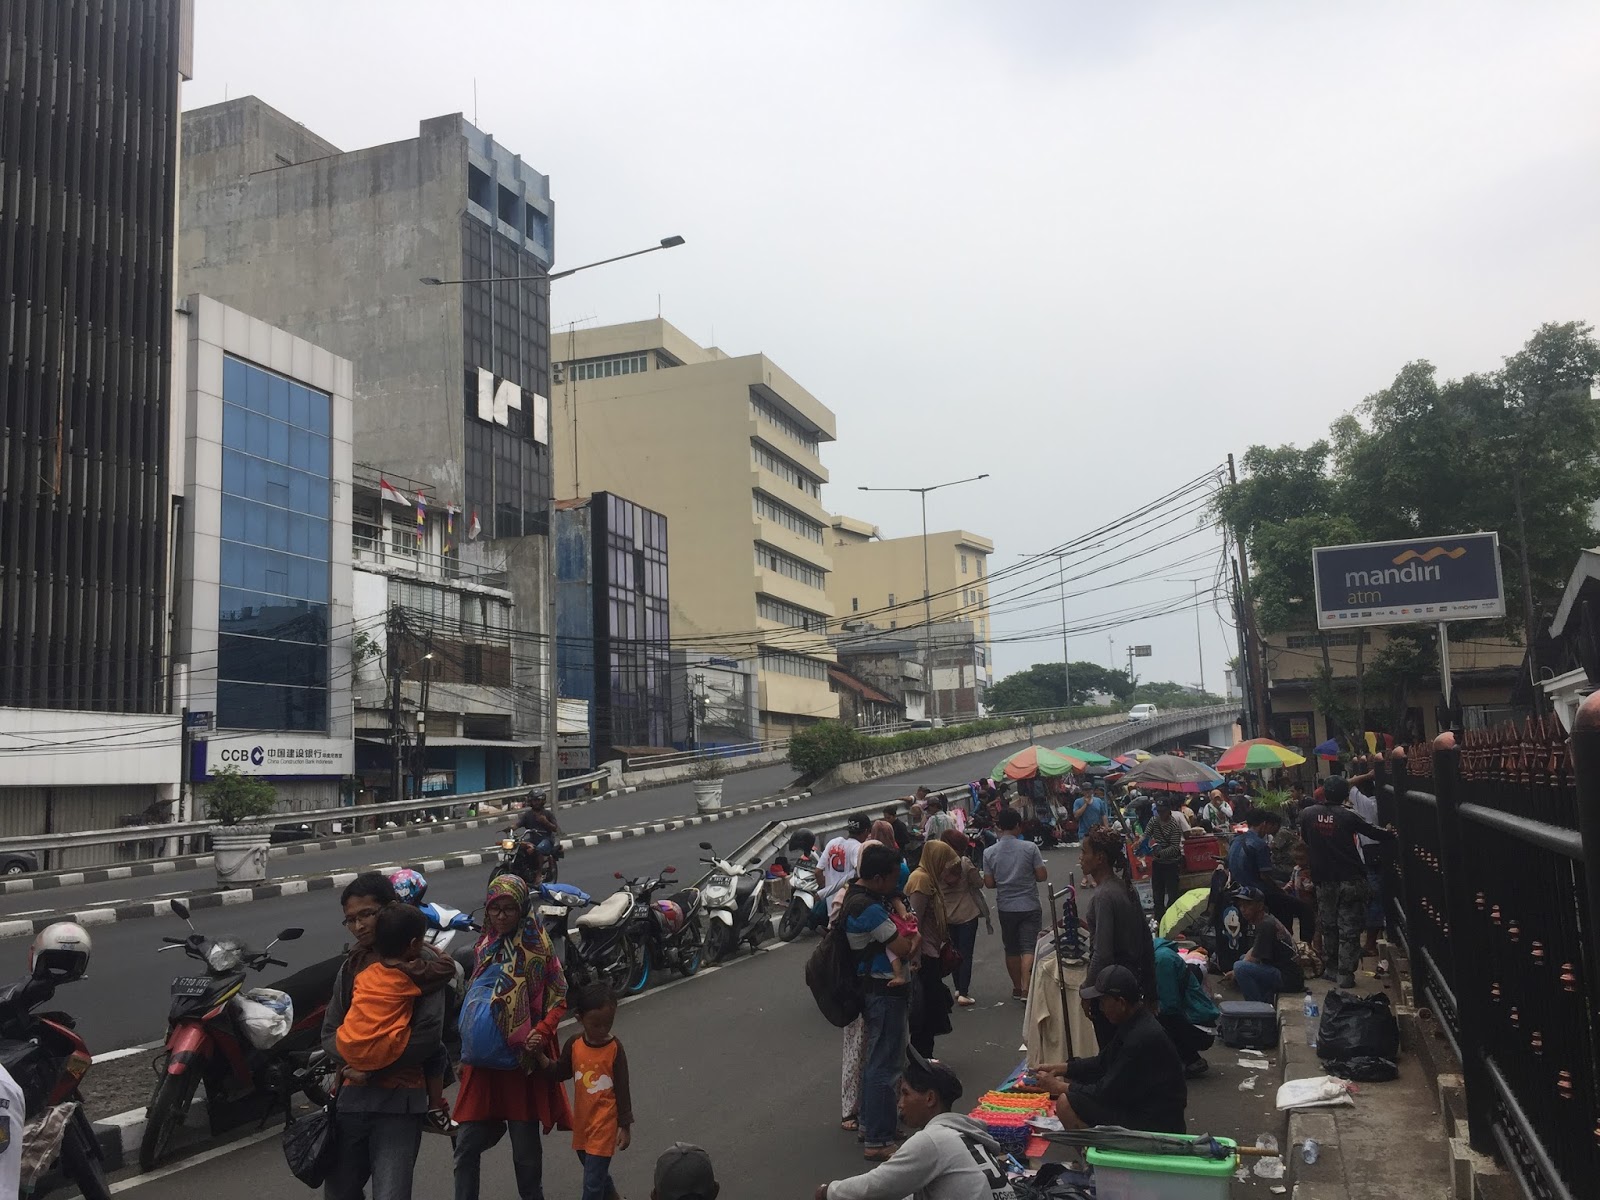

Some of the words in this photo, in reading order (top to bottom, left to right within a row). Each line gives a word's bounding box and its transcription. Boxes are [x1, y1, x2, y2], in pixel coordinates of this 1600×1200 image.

[1345, 562, 1441, 587] mandiri
[1347, 590, 1382, 604] atm
[221, 749, 249, 761] CCB
[267, 748, 322, 759] 中国建设银行
[1317, 814, 1334, 823] UJE
